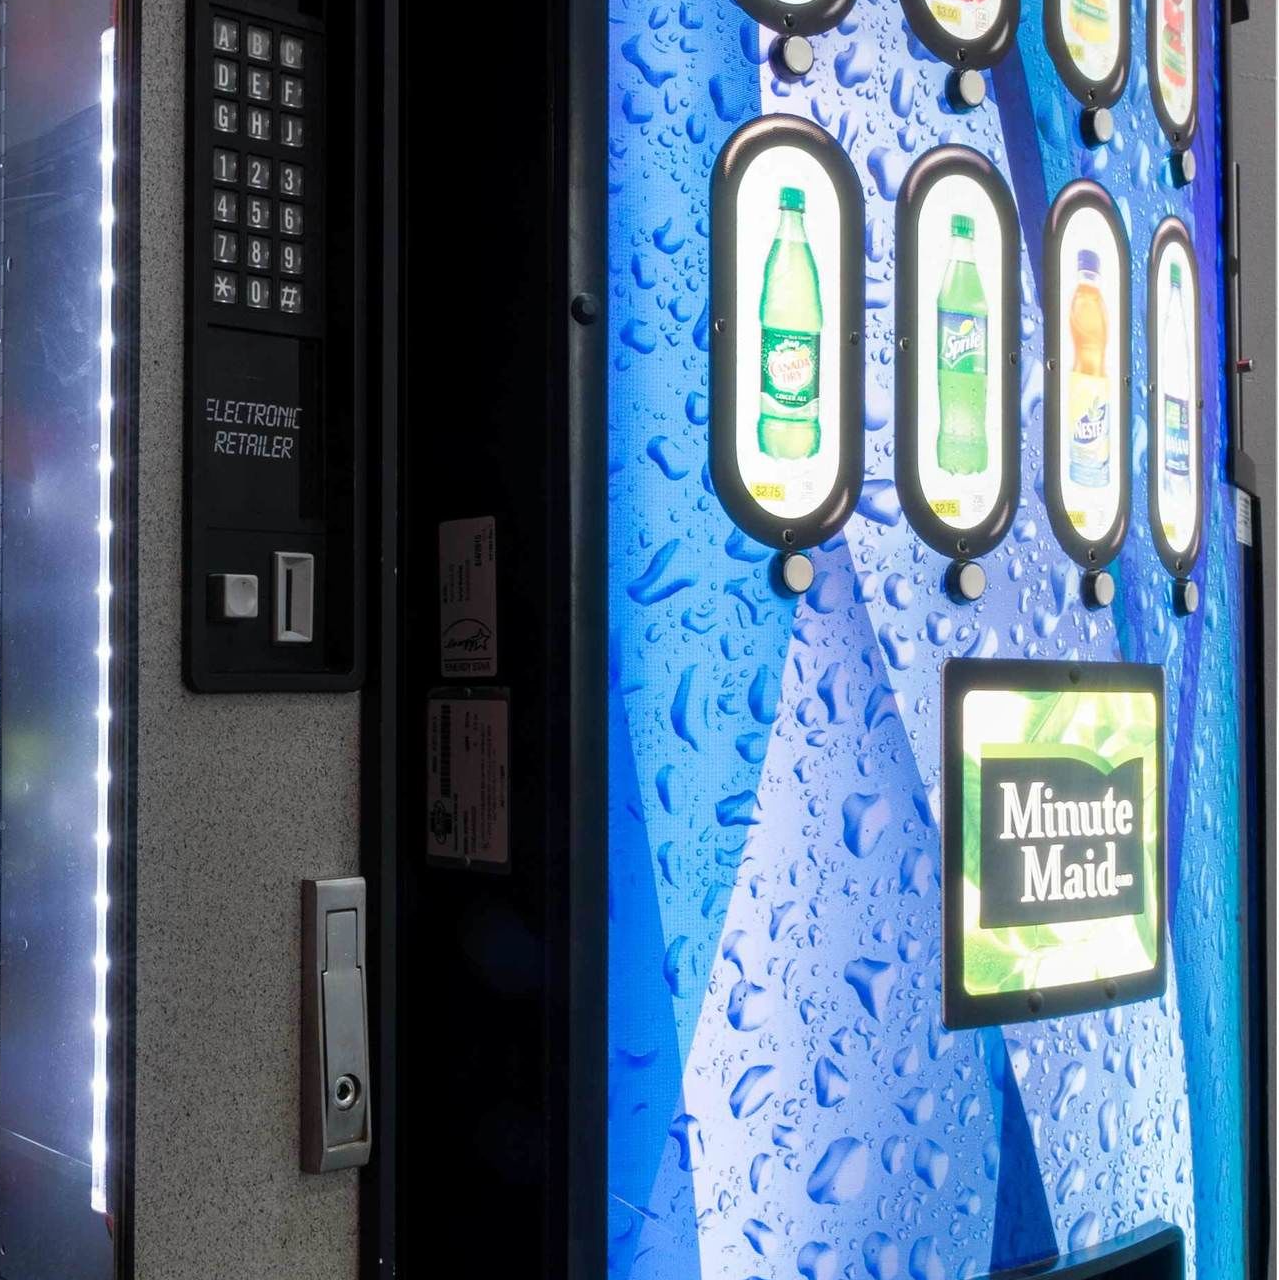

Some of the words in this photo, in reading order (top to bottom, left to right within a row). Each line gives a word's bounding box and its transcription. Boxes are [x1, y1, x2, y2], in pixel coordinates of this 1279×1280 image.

[218, 25, 230, 49] A
[251, 33, 263, 56] B
[285, 41, 295, 65] C
[218, 64, 229, 87] D
[251, 72, 262, 96] E
[284, 80, 294, 103] F
[218, 104, 229, 128] G
[251, 111, 263, 135] H
[285, 120, 294, 143] J
[219, 154, 227, 177] 1
[251, 161, 262, 184] 2
[284, 168, 294, 191] 3
[217, 194, 229, 218] 4
[251, 201, 262, 224] 5
[284, 207, 294, 231] 6
[218, 234, 227, 257] 7
[251, 240, 262, 263] 8
[284, 246, 294, 269] 9
[250, 280, 262, 303] 0
[280, 285, 298, 308] #
[944, 328, 984, 359] Sprite
[206, 398, 303, 429] ELECTRONIC
[214, 430, 294, 459] RETAILER
[754, 484, 782, 499] $2.75
[933, 502, 958, 515] $2.75
[999, 781, 1134, 840] Minute
[1020, 841, 1119, 904] Maid
